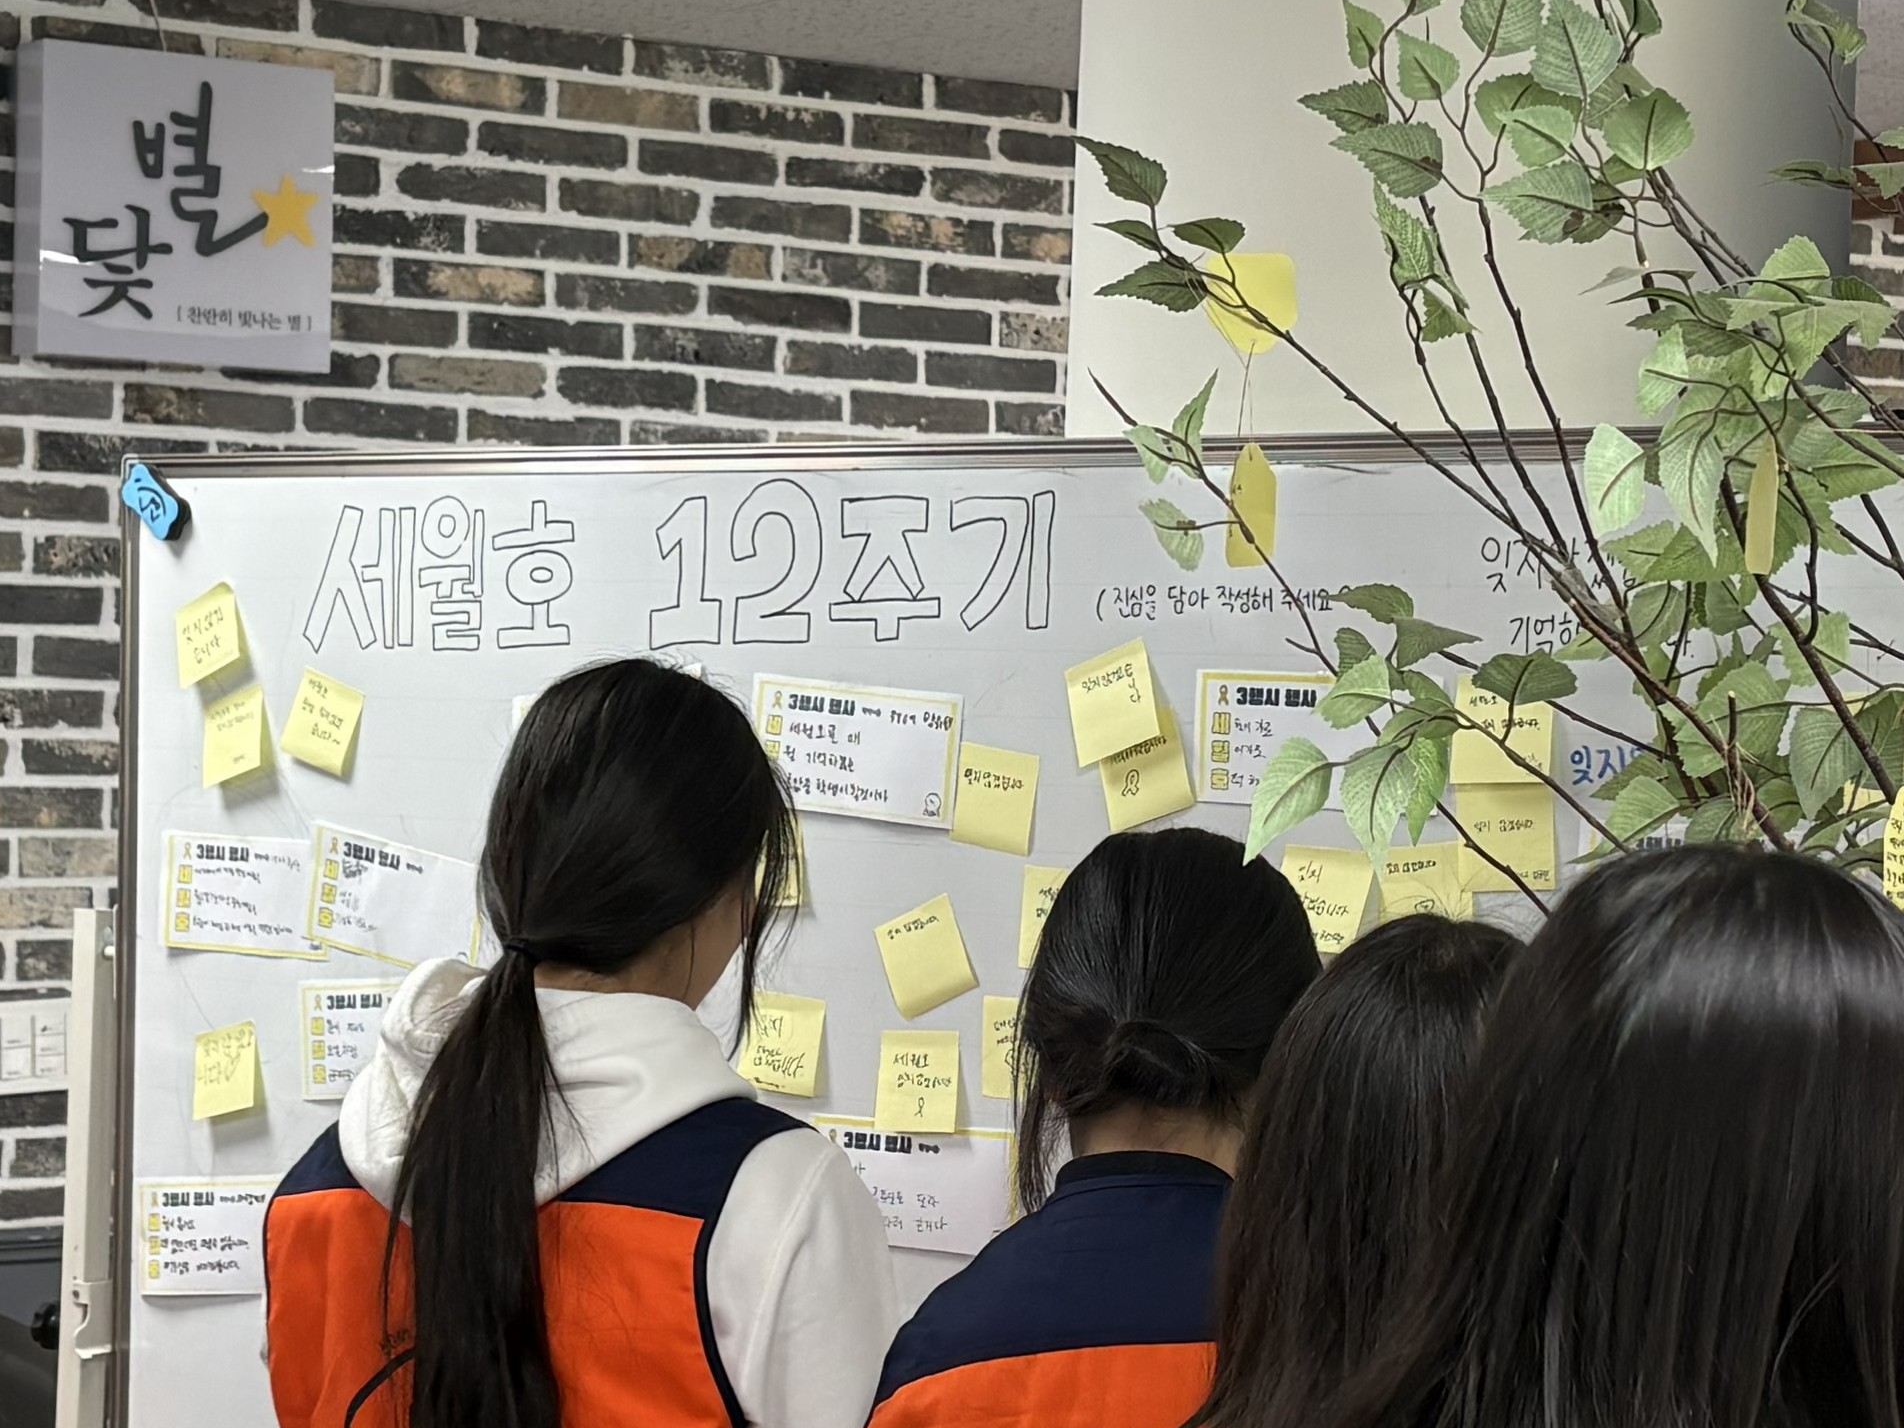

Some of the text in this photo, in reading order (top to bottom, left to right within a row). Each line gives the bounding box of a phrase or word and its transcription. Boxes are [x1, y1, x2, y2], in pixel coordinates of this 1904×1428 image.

[133, 80, 270, 258] 별
[238, 311, 282, 330] 빛나는
[303, 478, 1056, 652] 세월호 12주기
[1167, 585, 1210, 610] 담아
[1216, 584, 1273, 613] 작성해
[1235, 687, 1318, 710] 3행시 행사
